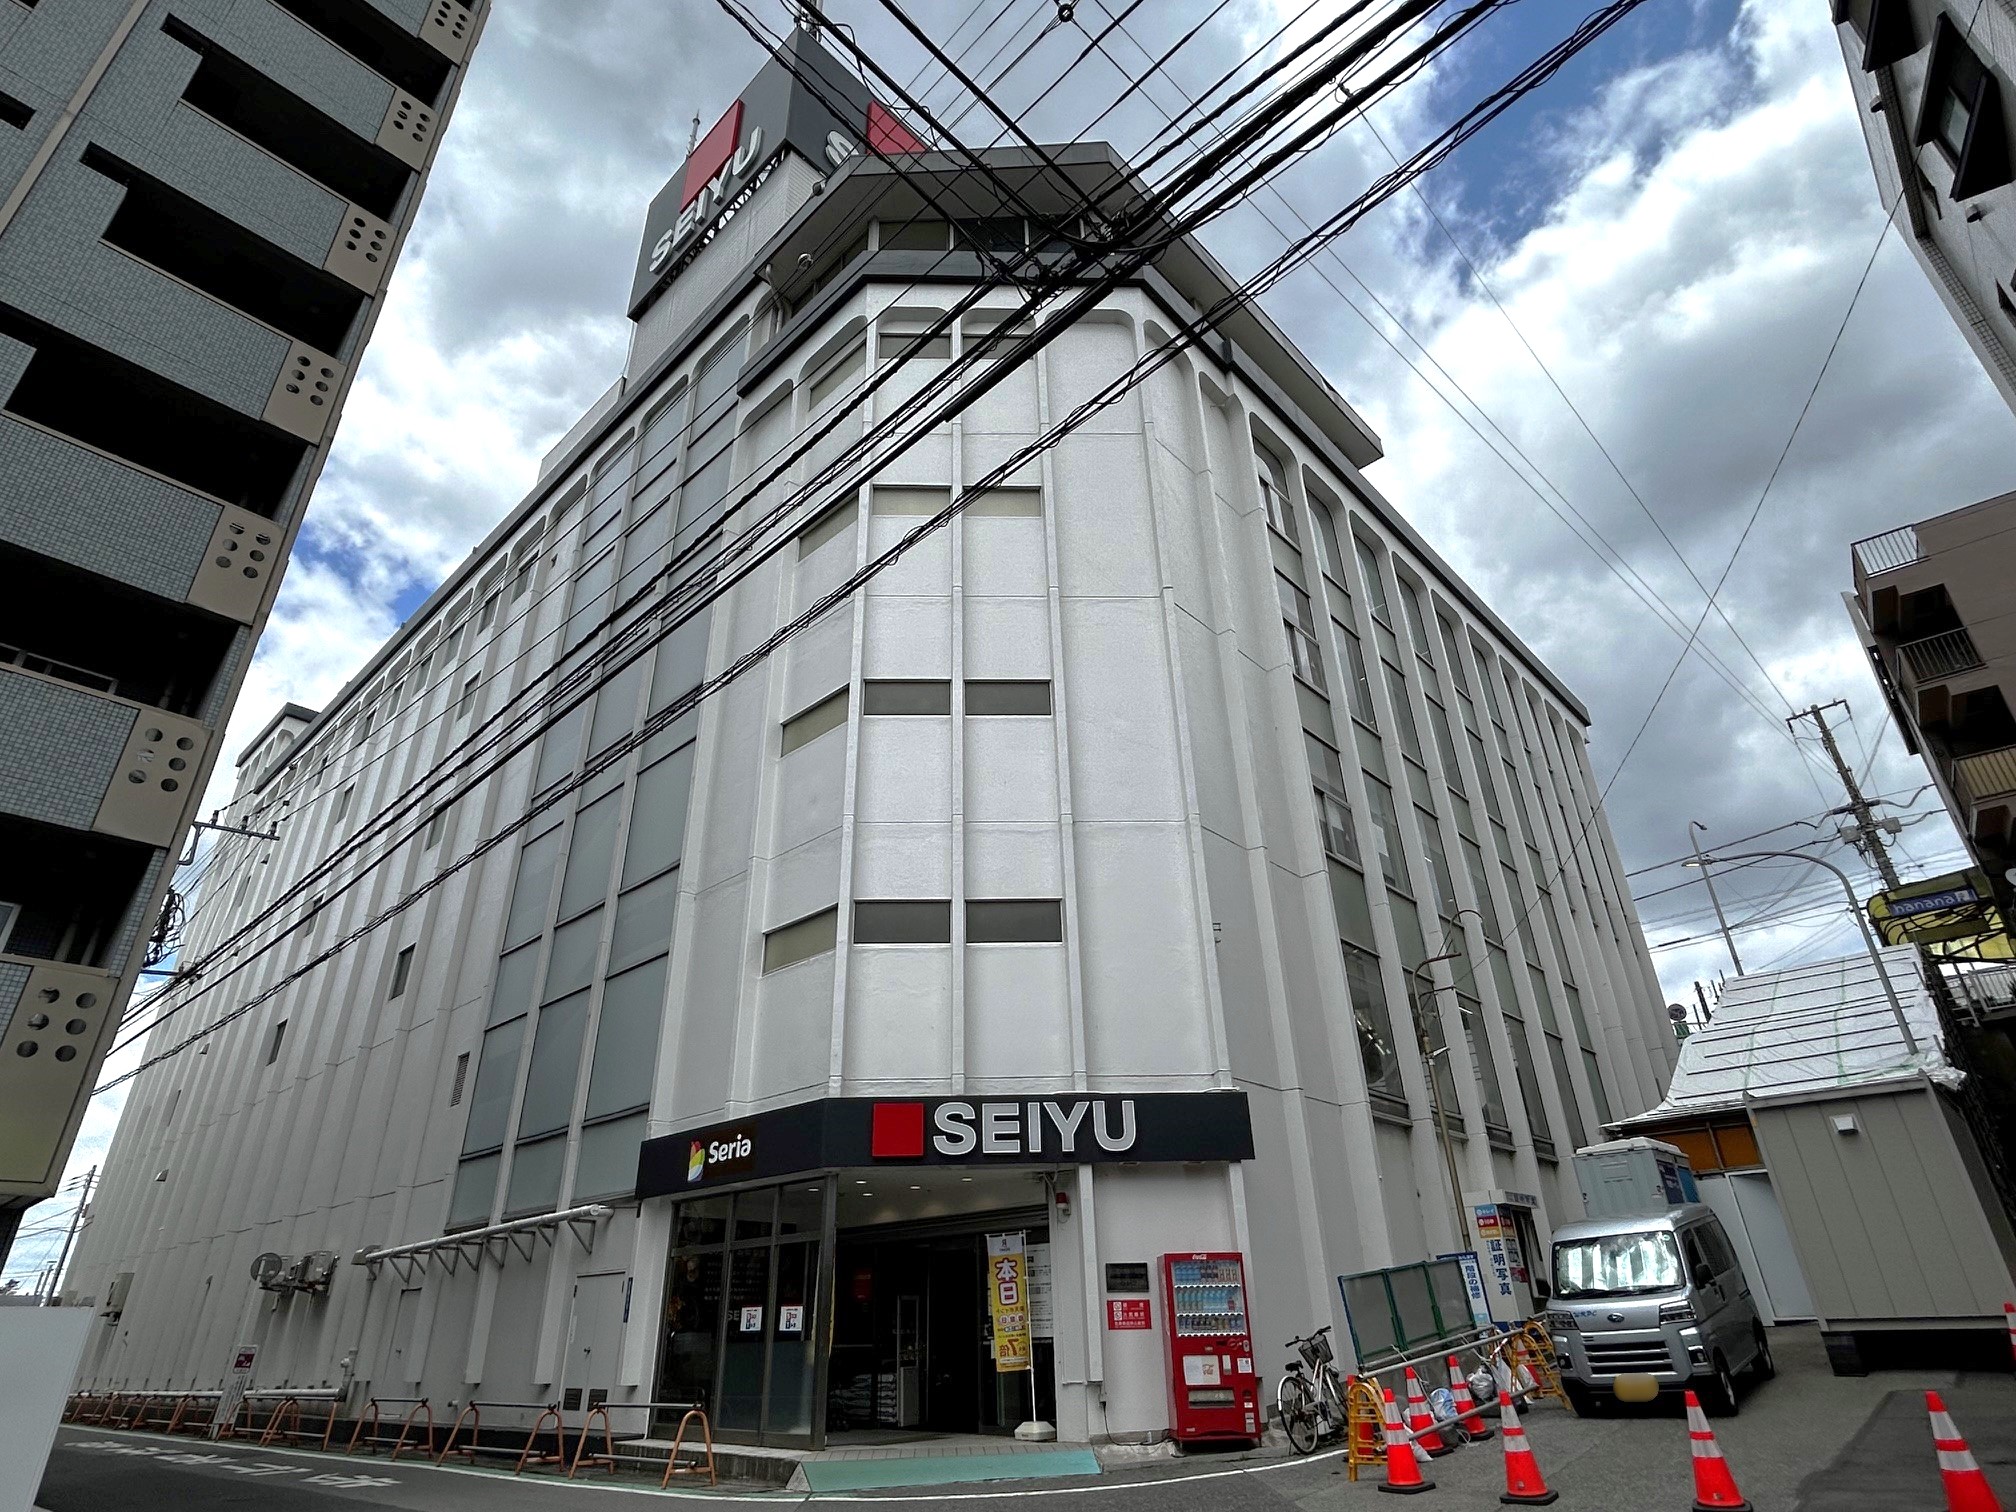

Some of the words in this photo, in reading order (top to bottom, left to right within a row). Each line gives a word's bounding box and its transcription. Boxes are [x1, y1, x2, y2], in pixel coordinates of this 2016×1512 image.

[649, 126, 764, 273] SEIYU
[708, 1134, 752, 1163] Seria
[932, 1100, 1137, 1155] SEIYU
[1465, 1265, 1481, 1299] 階段の補修
[1490, 1239, 1512, 1296] 証明写真
